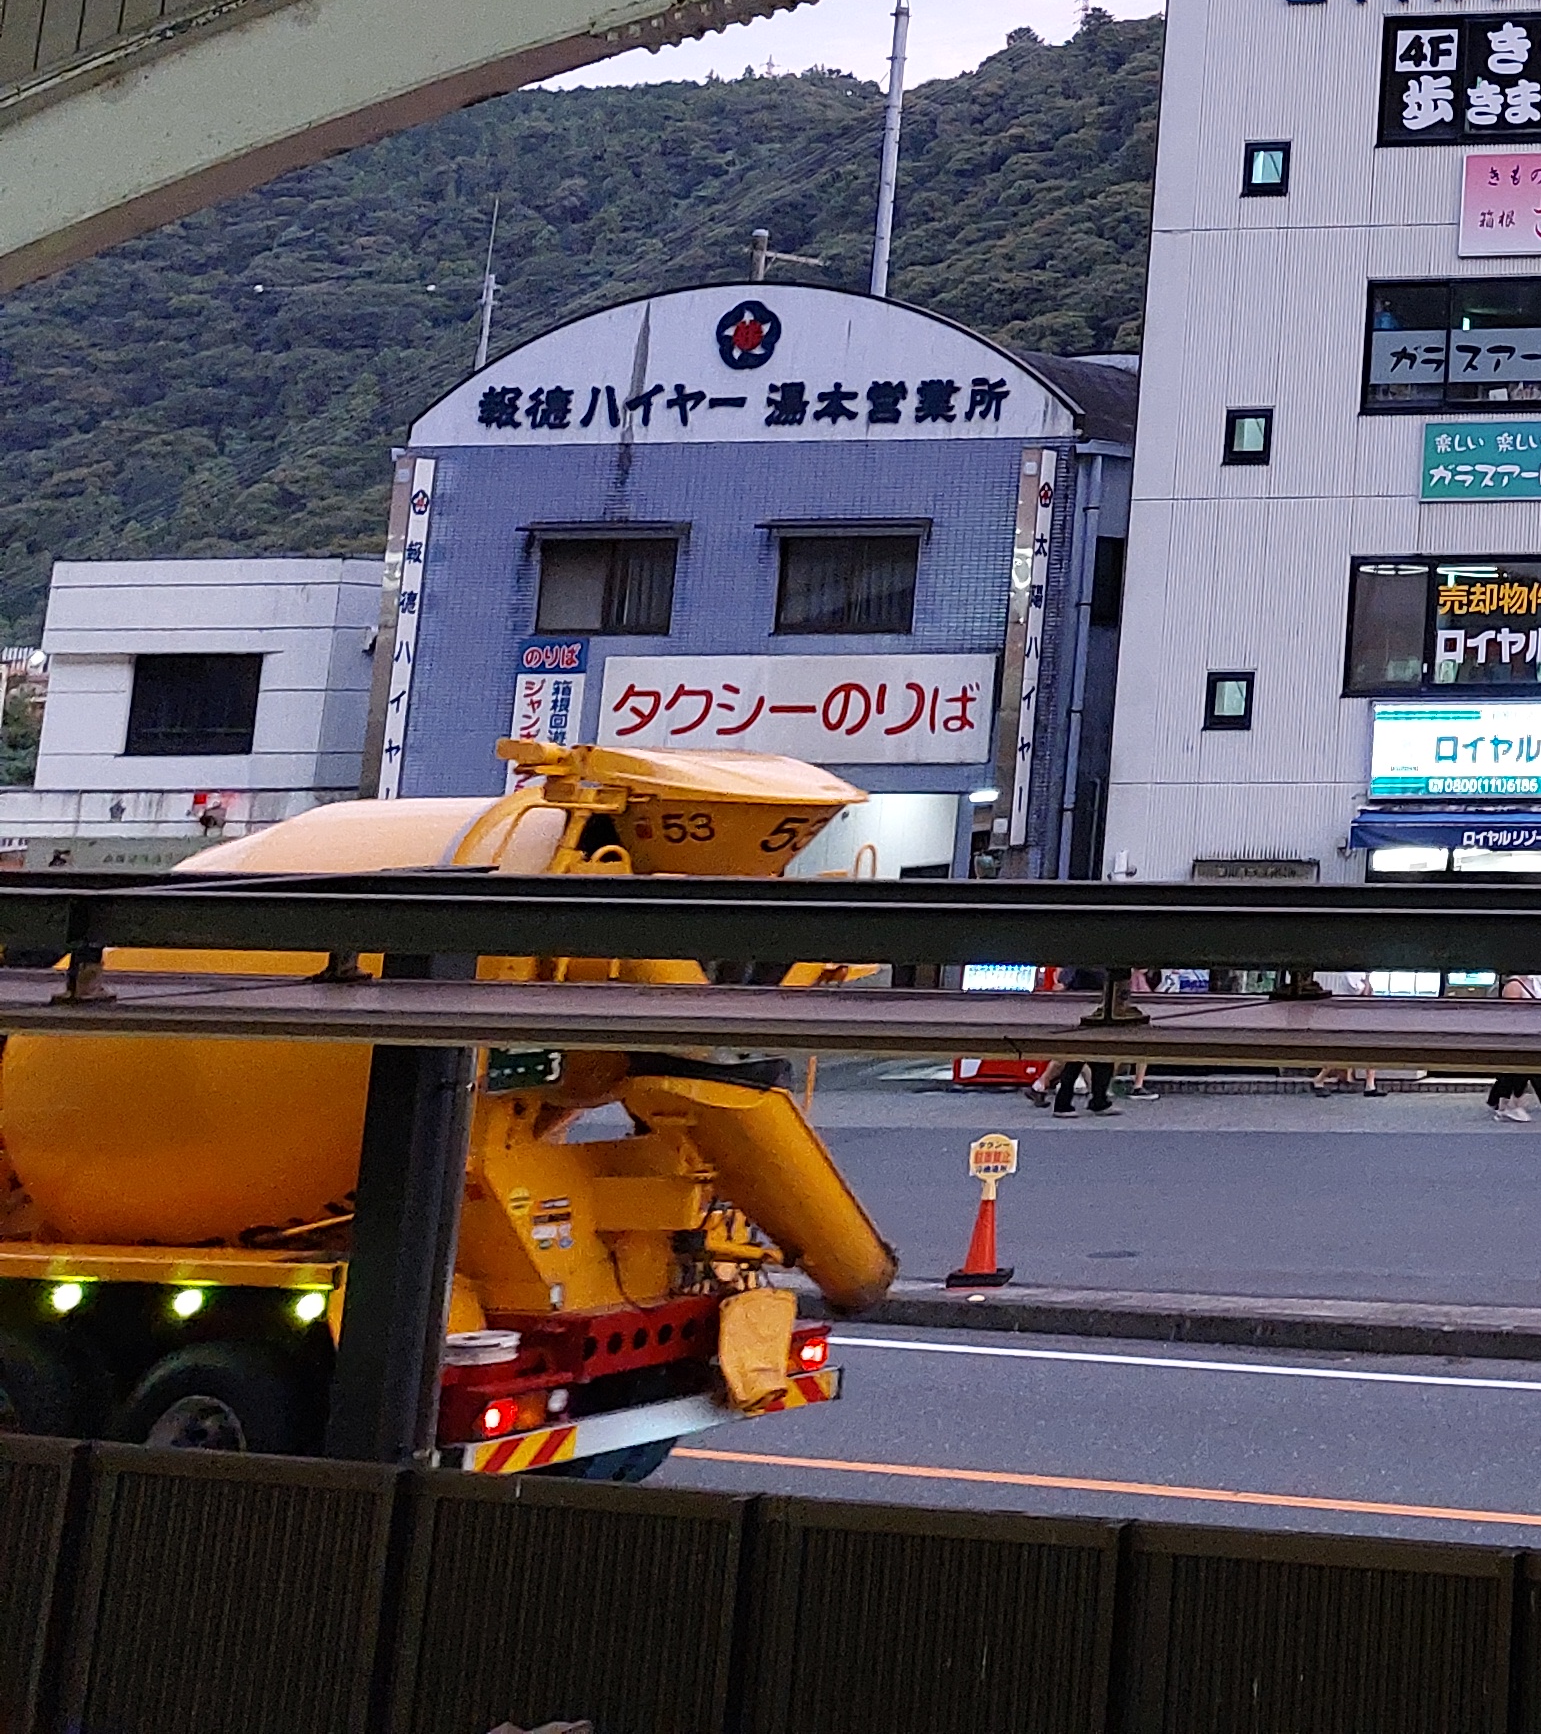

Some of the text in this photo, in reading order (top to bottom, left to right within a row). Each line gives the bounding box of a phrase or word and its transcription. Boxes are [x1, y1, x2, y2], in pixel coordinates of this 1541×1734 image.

[1398, 33, 1456, 69] 4F
[1479, 209, 1517, 229] 箱根
[765, 377, 1011, 426] 湯本営業所
[1434, 433, 1485, 454] 楽しい
[523, 642, 582, 669] のりば
[612, 681, 981, 737] タクシーのりば
[661, 812, 716, 844] 53
